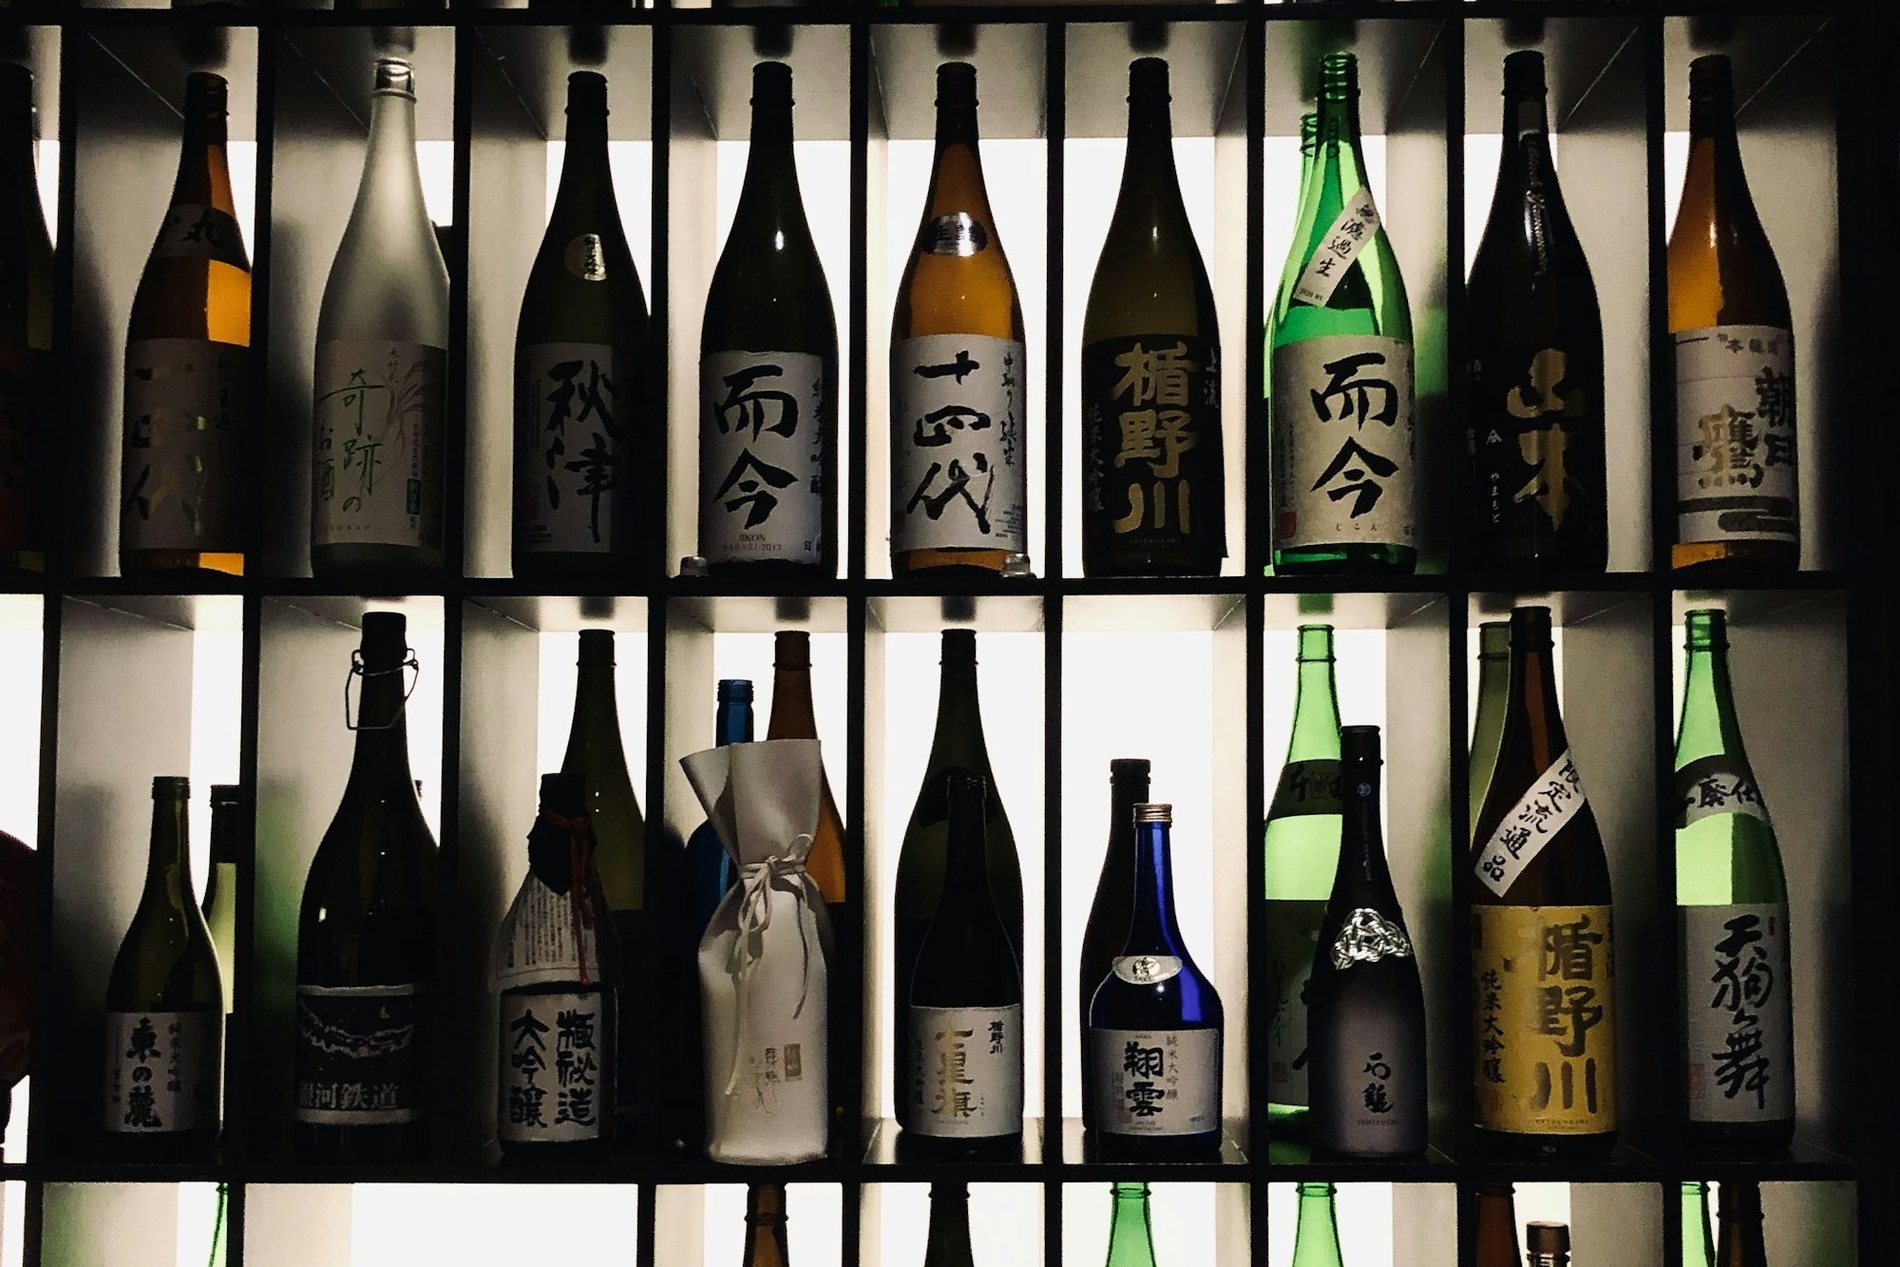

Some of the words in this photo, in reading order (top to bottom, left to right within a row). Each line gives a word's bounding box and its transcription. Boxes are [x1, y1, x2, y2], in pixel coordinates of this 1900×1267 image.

[318, 369, 386, 514] 奇跡の
[546, 361, 624, 544] 秋津
[713, 364, 800, 531] 而今
[906, 351, 992, 535] 十四代
[1111, 343, 1198, 536] 楯野川
[1309, 353, 1400, 520] 而今
[1482, 758, 1581, 882] 限定流通品
[124, 1016, 162, 1128] 東の麓
[510, 1009, 549, 1128] 大吟醸
[988, 1019, 1004, 1055] 楯野川
[1123, 1041, 1165, 1117] 翔雲
[1166, 1035, 1178, 1101] 純米大吟醸
[1480, 970, 1505, 1084] 純米大吟醸
[1711, 914, 1773, 1111] 天狗舞
